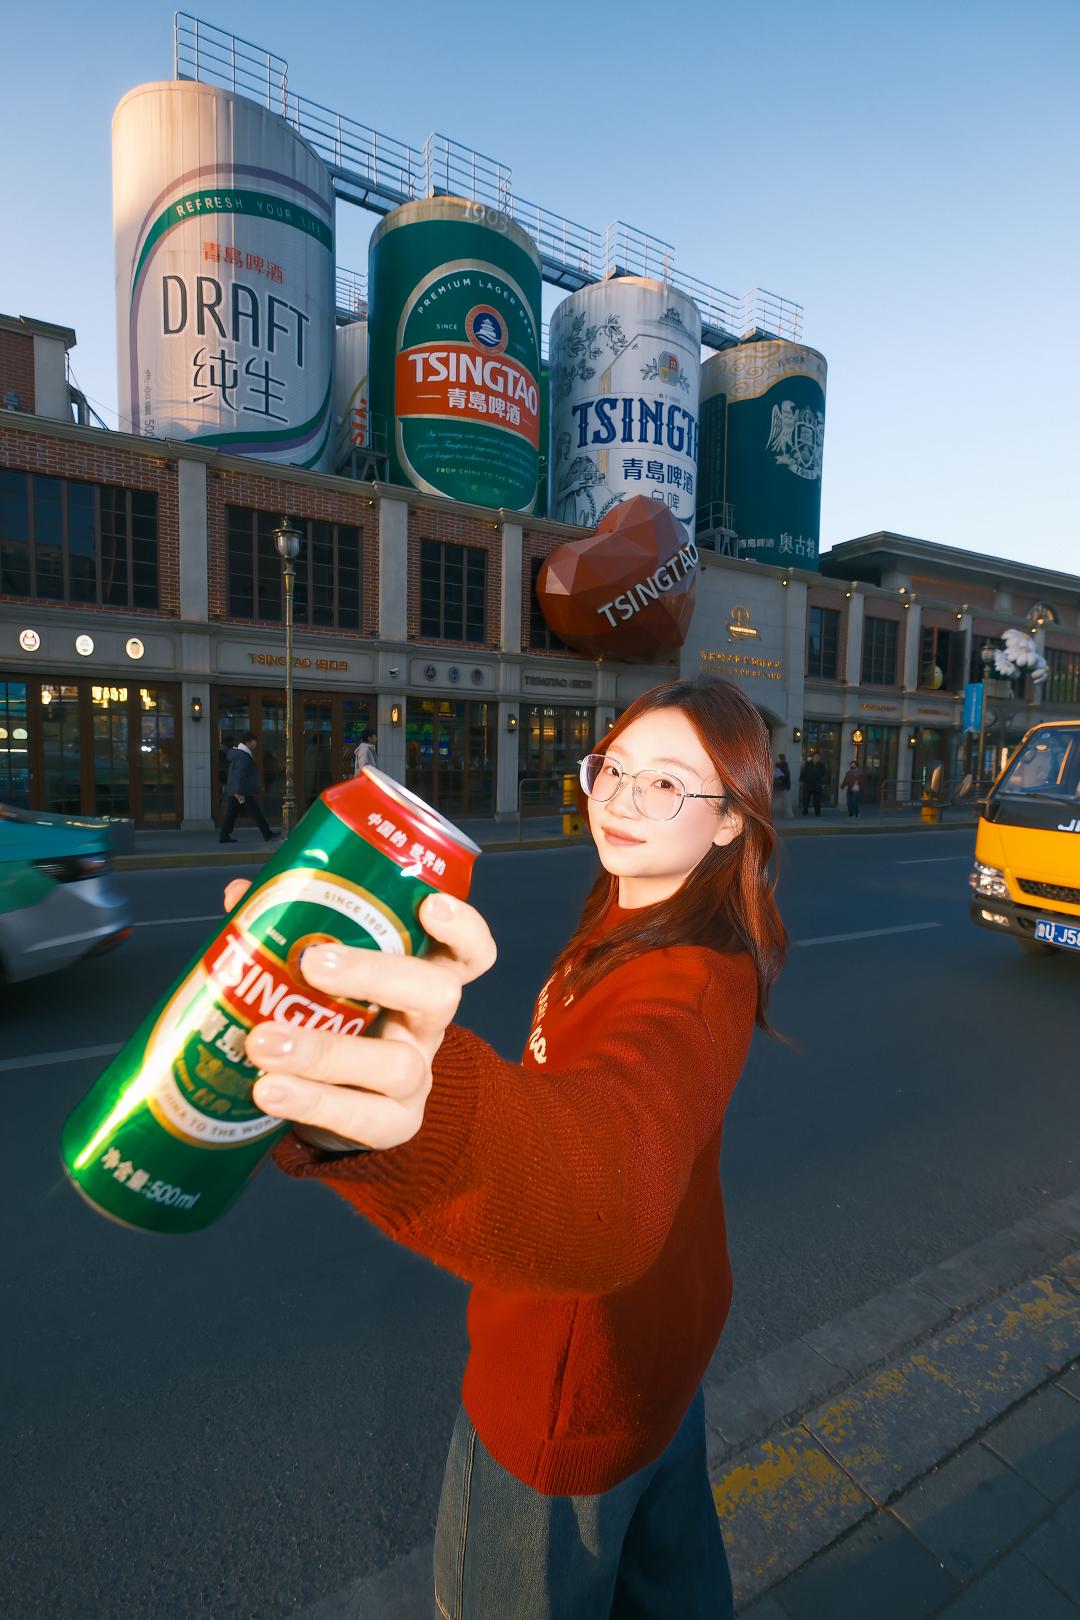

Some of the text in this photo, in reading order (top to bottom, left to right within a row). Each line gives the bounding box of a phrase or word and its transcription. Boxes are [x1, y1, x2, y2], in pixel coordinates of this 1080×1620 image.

[175, 196, 321, 237] REFRESH YOUR LIFE
[464, 201, 508, 233] 1903
[417, 278, 471, 314] PREMIUM
[479, 279, 516, 305] LAGER
[162, 275, 310, 368] DRAFT
[436, 323, 458, 331] SINCE
[192, 346, 289, 423] 纯生
[408, 352, 538, 417] TSINGTAO
[447, 387, 521, 426] 青島啤酒
[459, 468, 481, 476] CHINA
[621, 457, 694, 495] 青島啤酒
[778, 532, 816, 560] 奥古特
[597, 543, 699, 628] TSINGTAO
[248, 652, 312, 669] TSINGAO
[367, 812, 447, 876] 中国的 世界的
[323, 890, 388, 937] SINCE 1903
[190, 1118, 207, 1133] TO
[210, 1126, 237, 1138] THE
